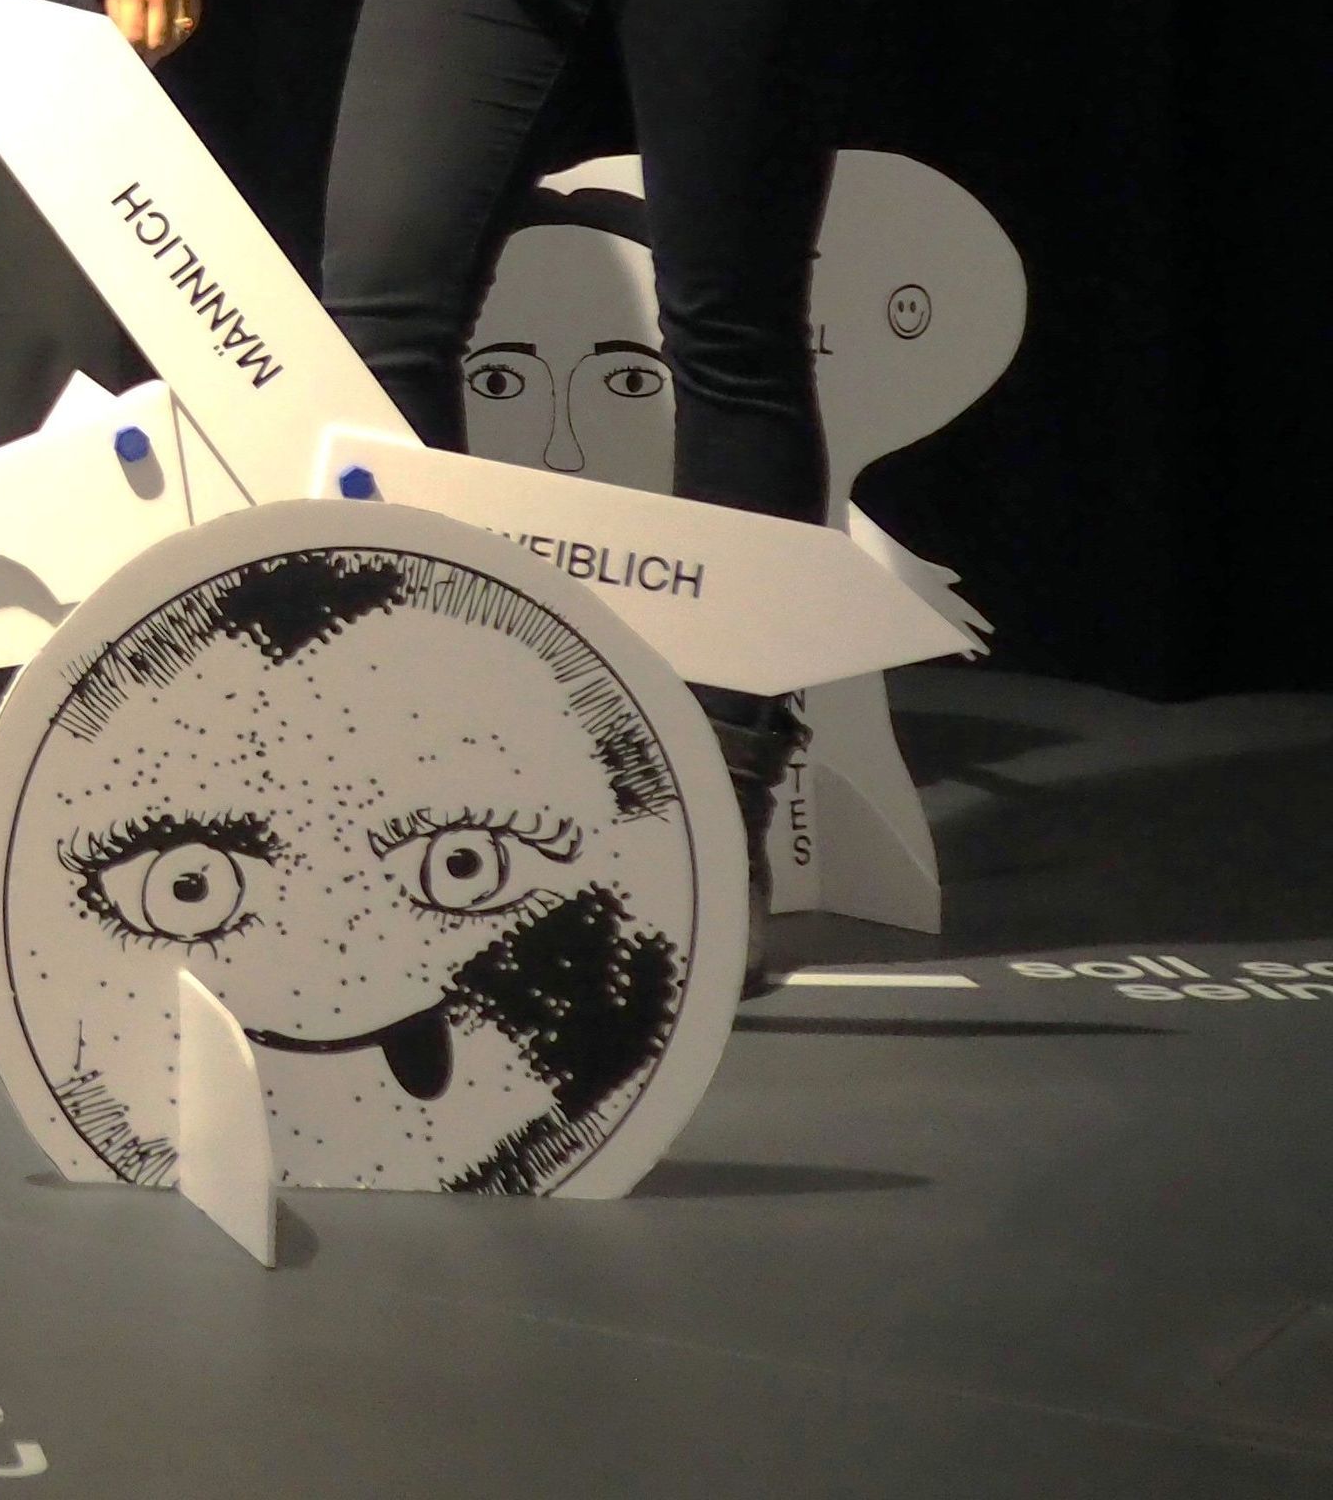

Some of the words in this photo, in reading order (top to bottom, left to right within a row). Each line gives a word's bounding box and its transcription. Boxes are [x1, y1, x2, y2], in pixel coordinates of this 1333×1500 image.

[110, 181, 284, 390] MÄNNLICH
[486, 526, 705, 599] EIBLICH
[1007, 954, 1212, 979] soll
